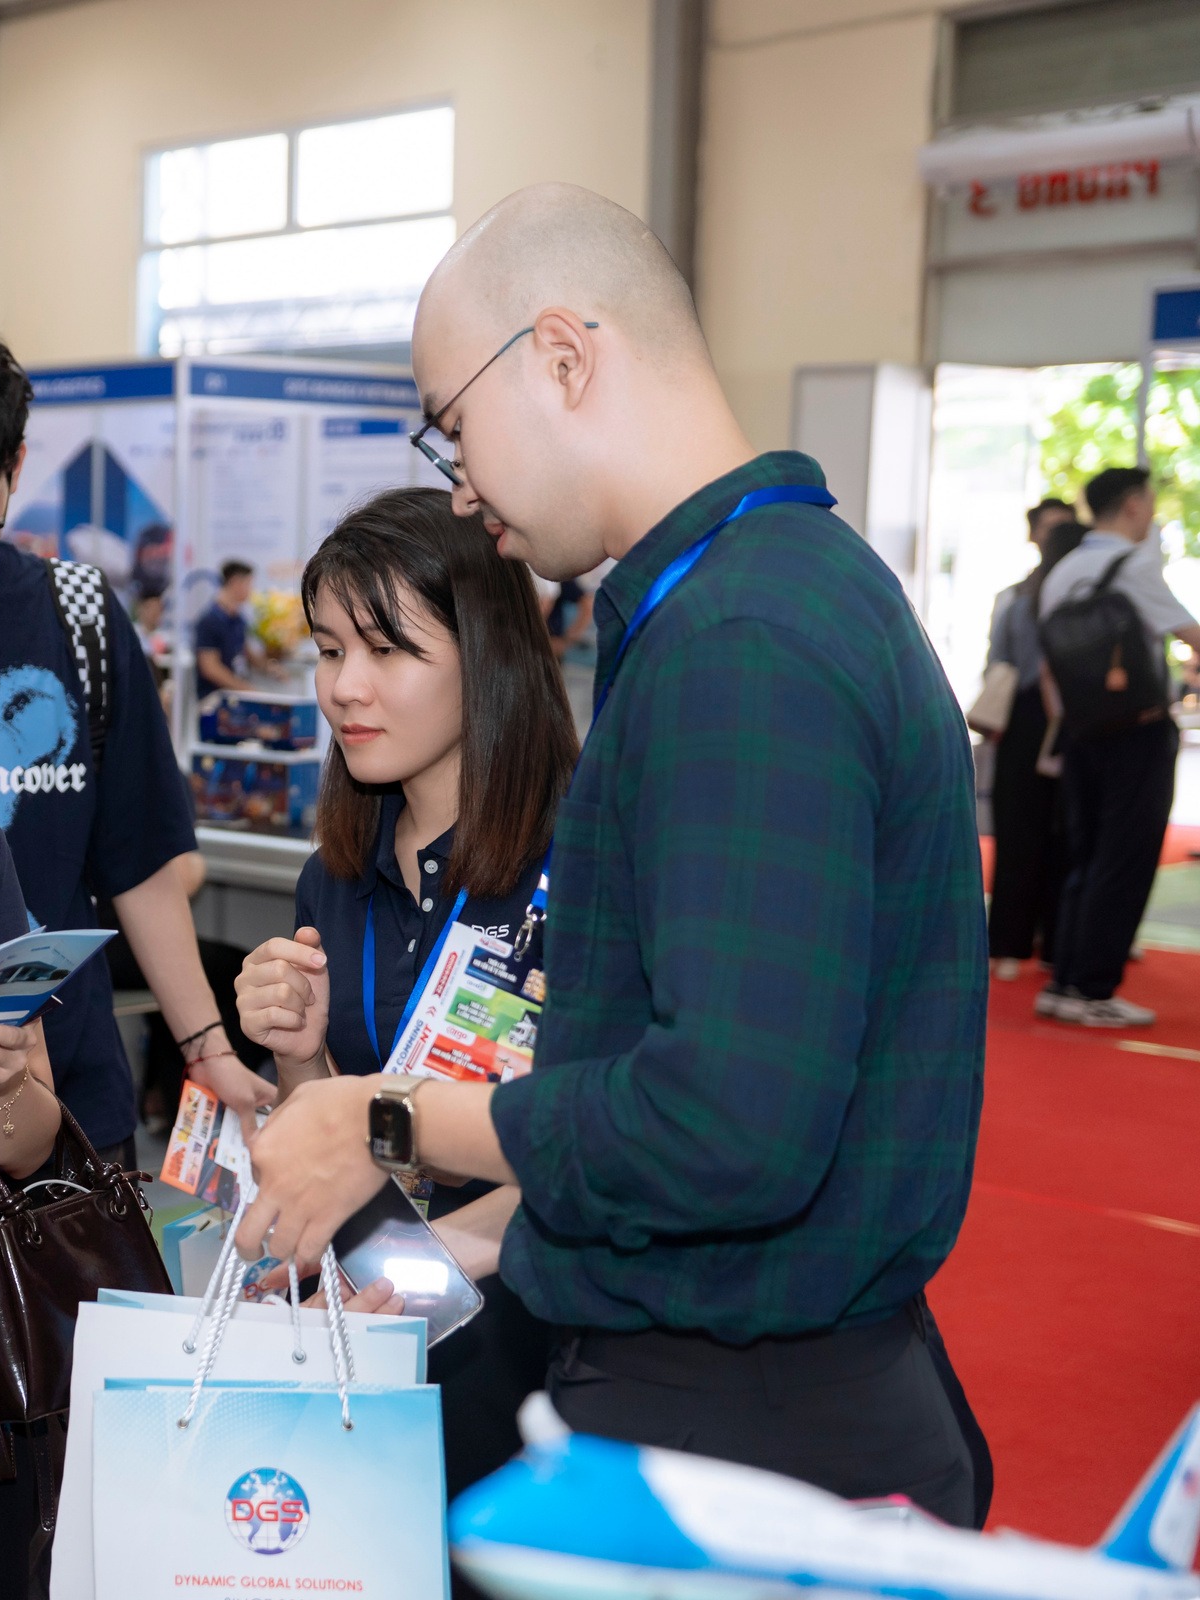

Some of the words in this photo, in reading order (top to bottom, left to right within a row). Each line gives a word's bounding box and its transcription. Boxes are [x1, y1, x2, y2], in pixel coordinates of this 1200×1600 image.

[397, 1018, 424, 1065] COMMING
[231, 1498, 304, 1523] DGS
[174, 1574, 236, 1587] DYNAMIC
[240, 1575, 291, 1589] GLOBAL
[295, 1577, 364, 1592] SOLUTIONS
